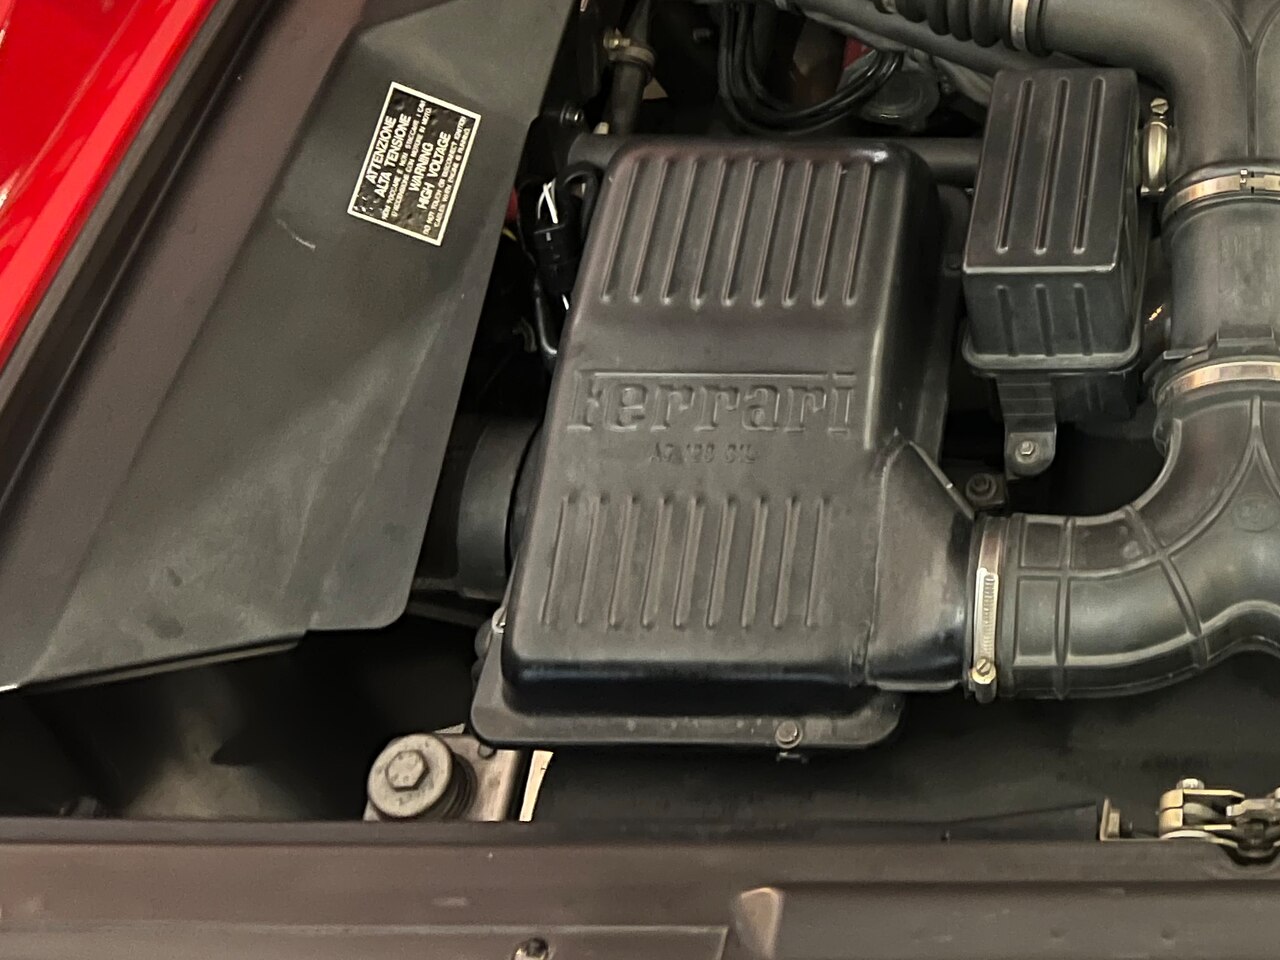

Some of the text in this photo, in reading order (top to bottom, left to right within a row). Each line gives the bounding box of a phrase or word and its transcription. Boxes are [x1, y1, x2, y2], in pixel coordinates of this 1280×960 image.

[365, 116, 396, 183] ATTENZIONE
[374, 113, 411, 197] ALTA TENSIONE
[408, 142, 433, 191] WARNING
[416, 131, 450, 209] HIGH VOLTAGE
[566, 370, 855, 431] Ferrari
